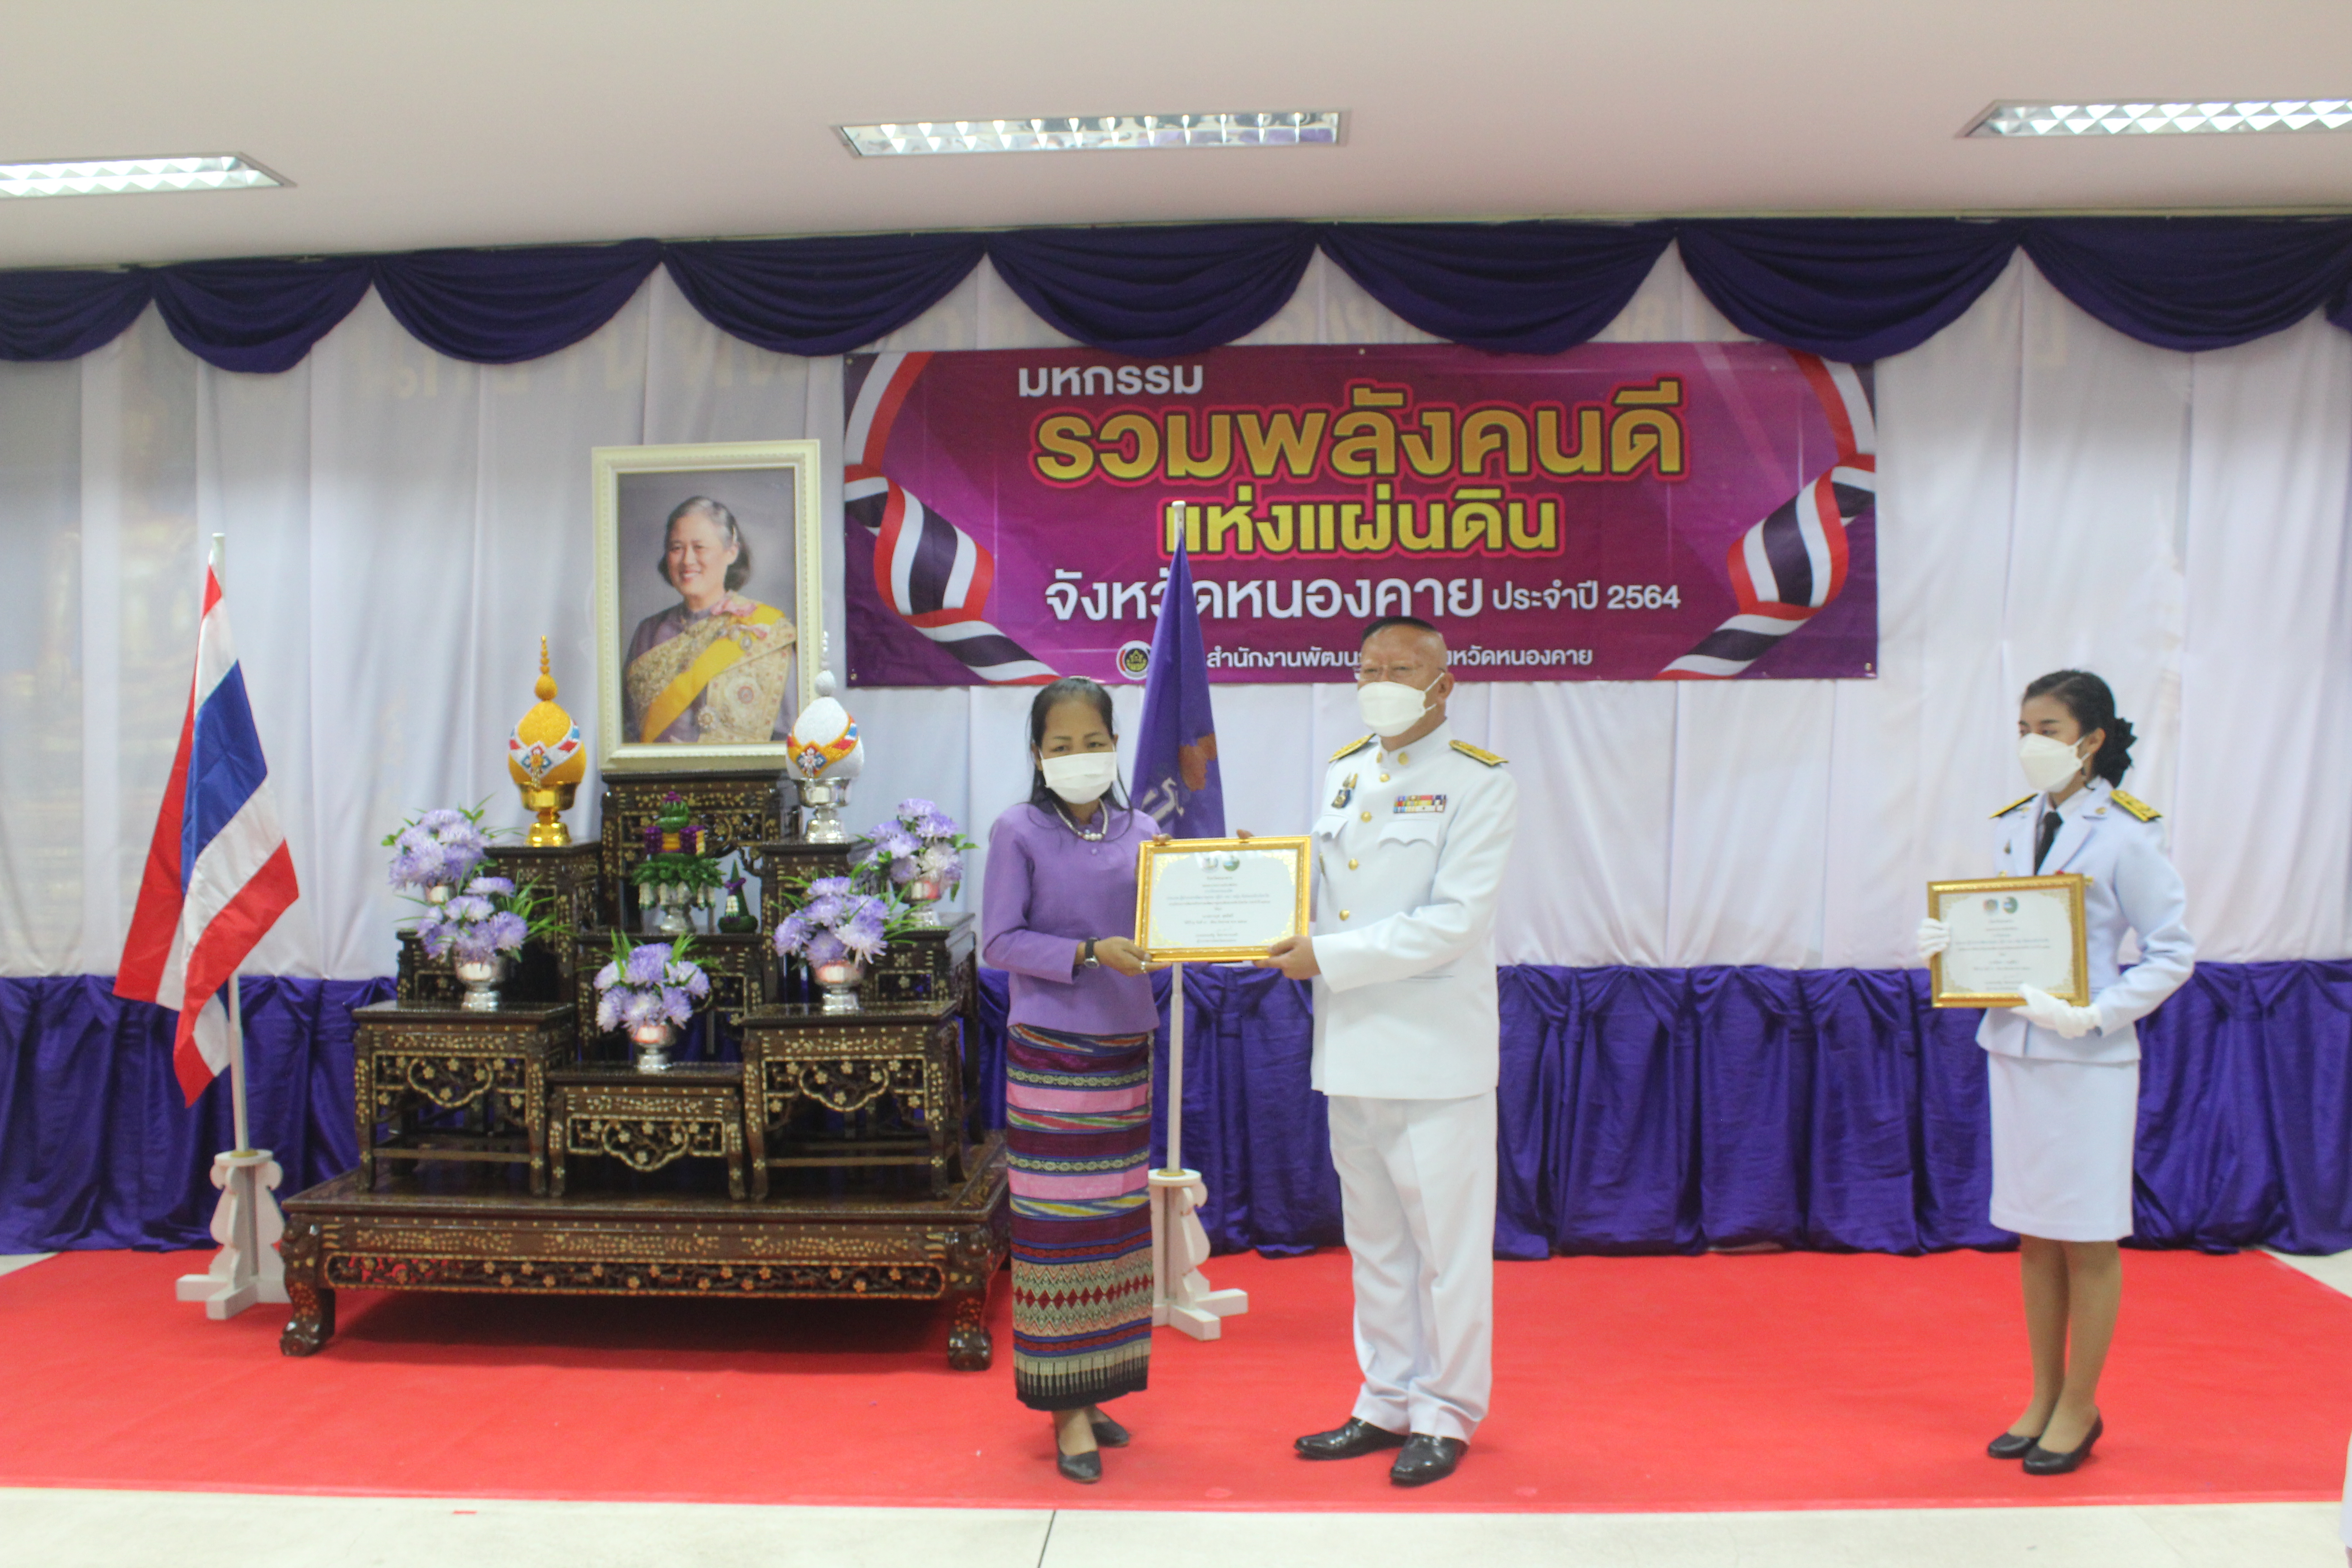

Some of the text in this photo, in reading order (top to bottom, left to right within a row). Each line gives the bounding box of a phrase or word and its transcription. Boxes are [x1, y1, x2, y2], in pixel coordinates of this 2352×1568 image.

[1019, 365, 1203, 397] มหกรรม
[1036, 380, 1681, 479] รวมพลังคนดี
[1166, 484, 1556, 552] แห่งแผ่นดิน
[1492, 579, 1599, 610] ประจำปี
[1607, 584, 1681, 609] 2564
